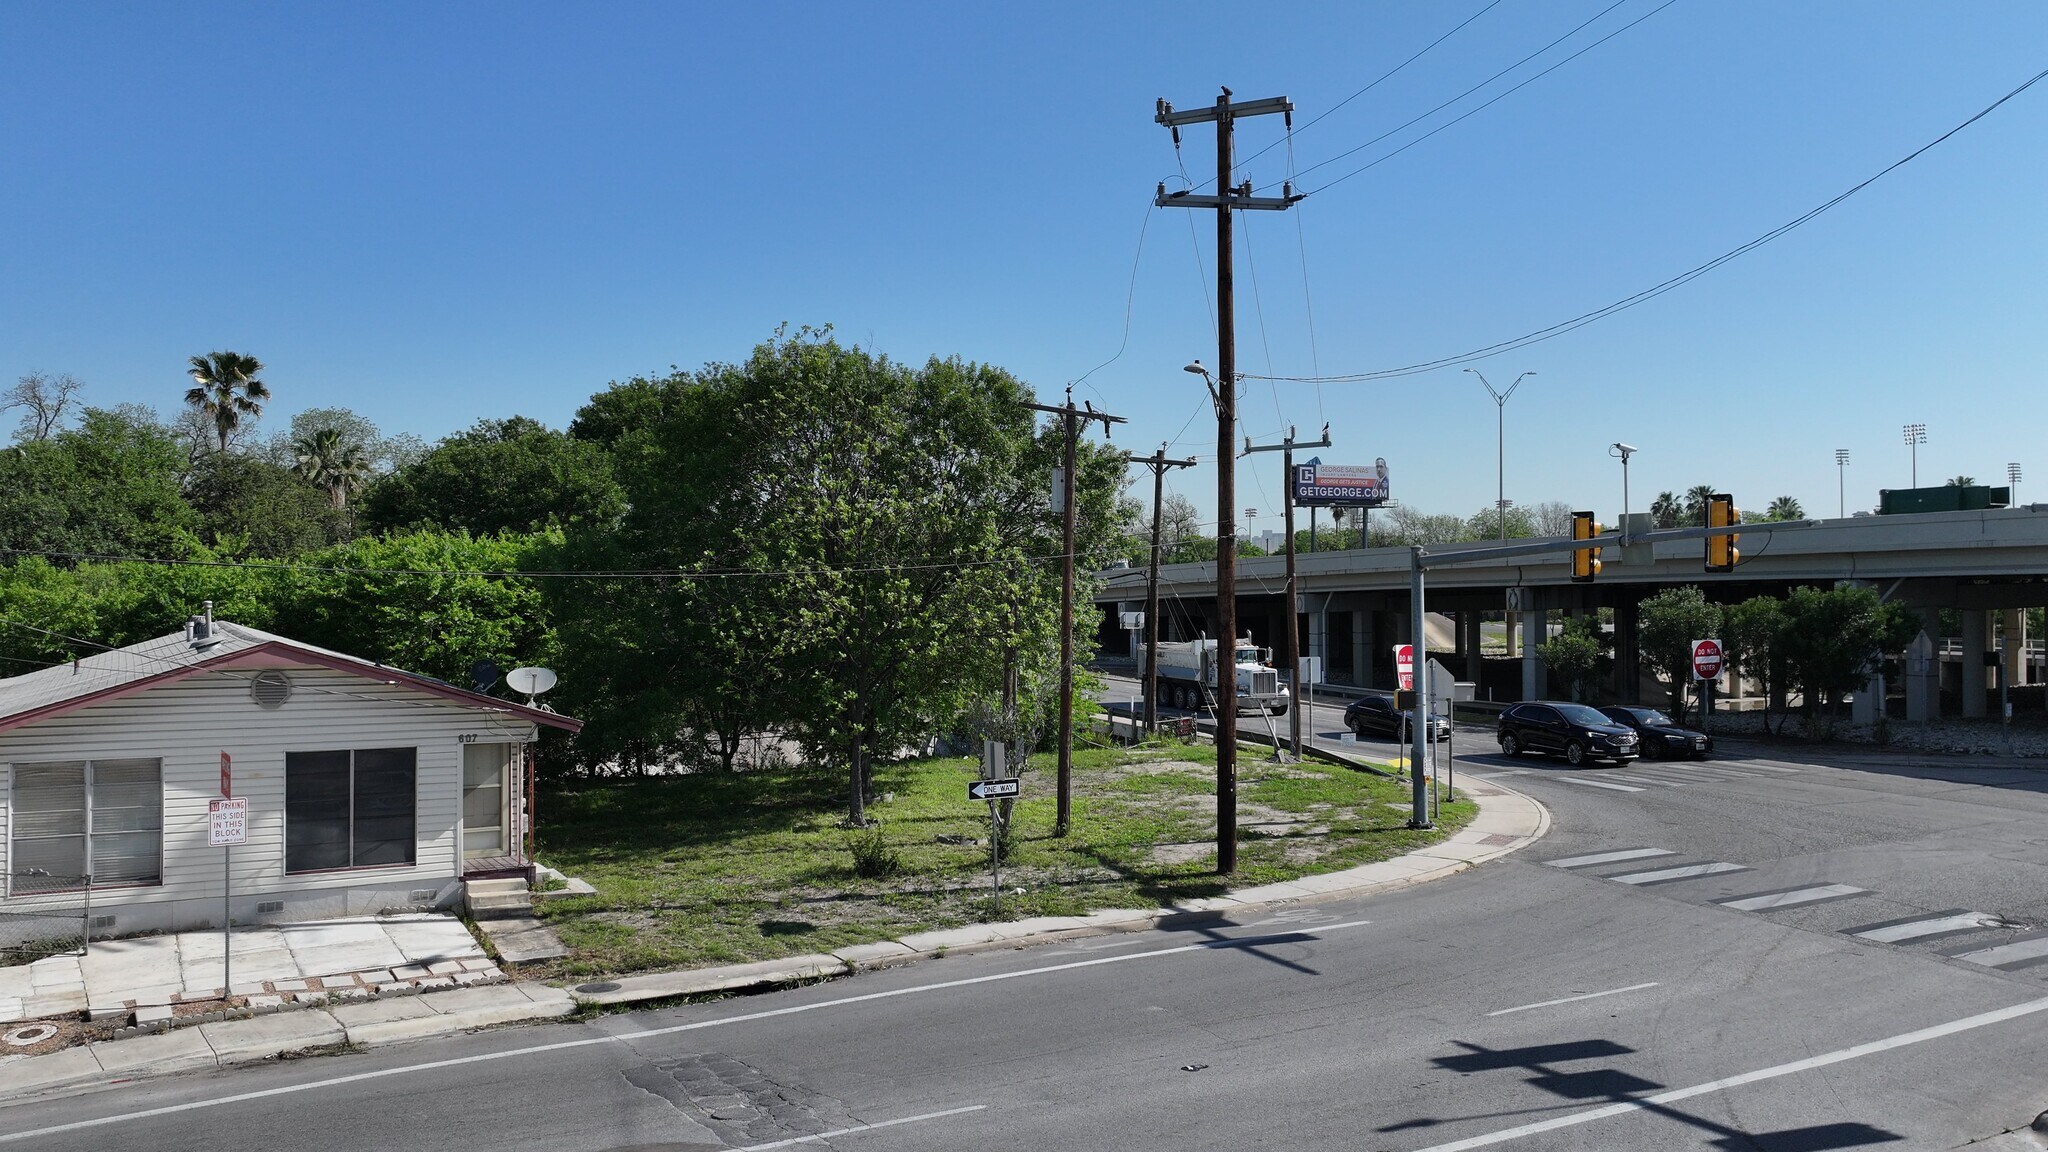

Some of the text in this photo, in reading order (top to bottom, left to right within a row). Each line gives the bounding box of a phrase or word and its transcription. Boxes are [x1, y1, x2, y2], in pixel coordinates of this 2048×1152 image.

[1300, 487, 1387, 498] GETGEORGE.COM
[458, 734, 478, 743] 607
[211, 801, 244, 810] NO PARKING
[216, 829, 241, 837] BLOCK
